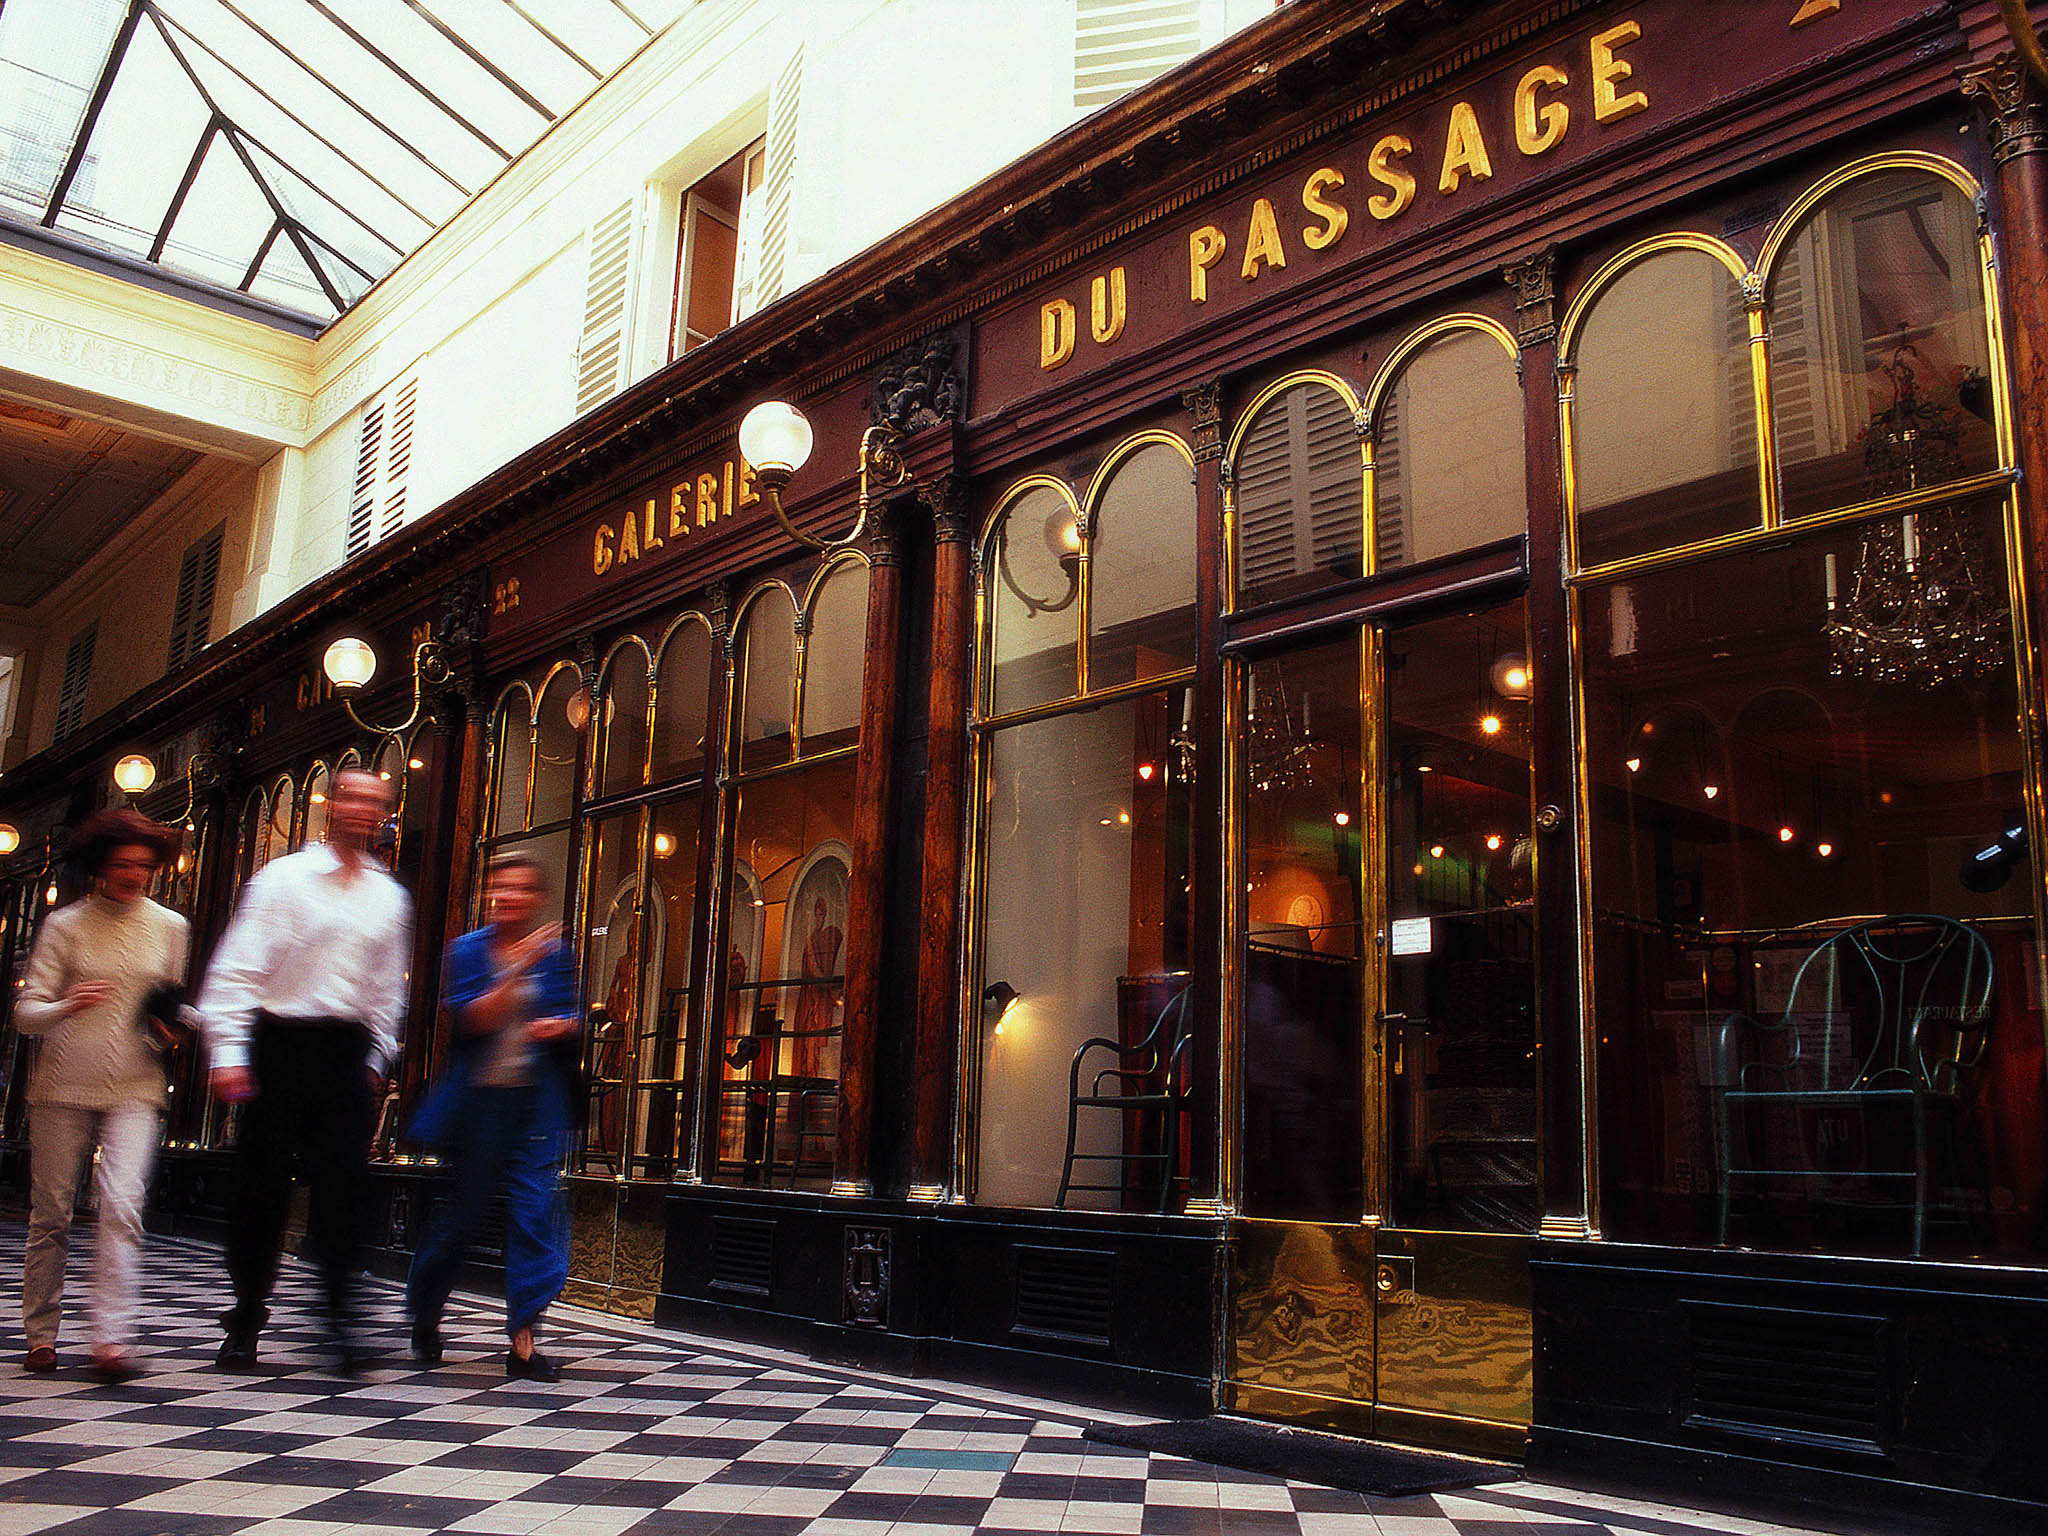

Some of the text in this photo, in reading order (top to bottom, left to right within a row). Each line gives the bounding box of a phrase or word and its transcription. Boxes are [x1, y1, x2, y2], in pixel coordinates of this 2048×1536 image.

[1041, 20, 1649, 371] DU PASSAGE
[593, 458, 761, 576] GALERIE
